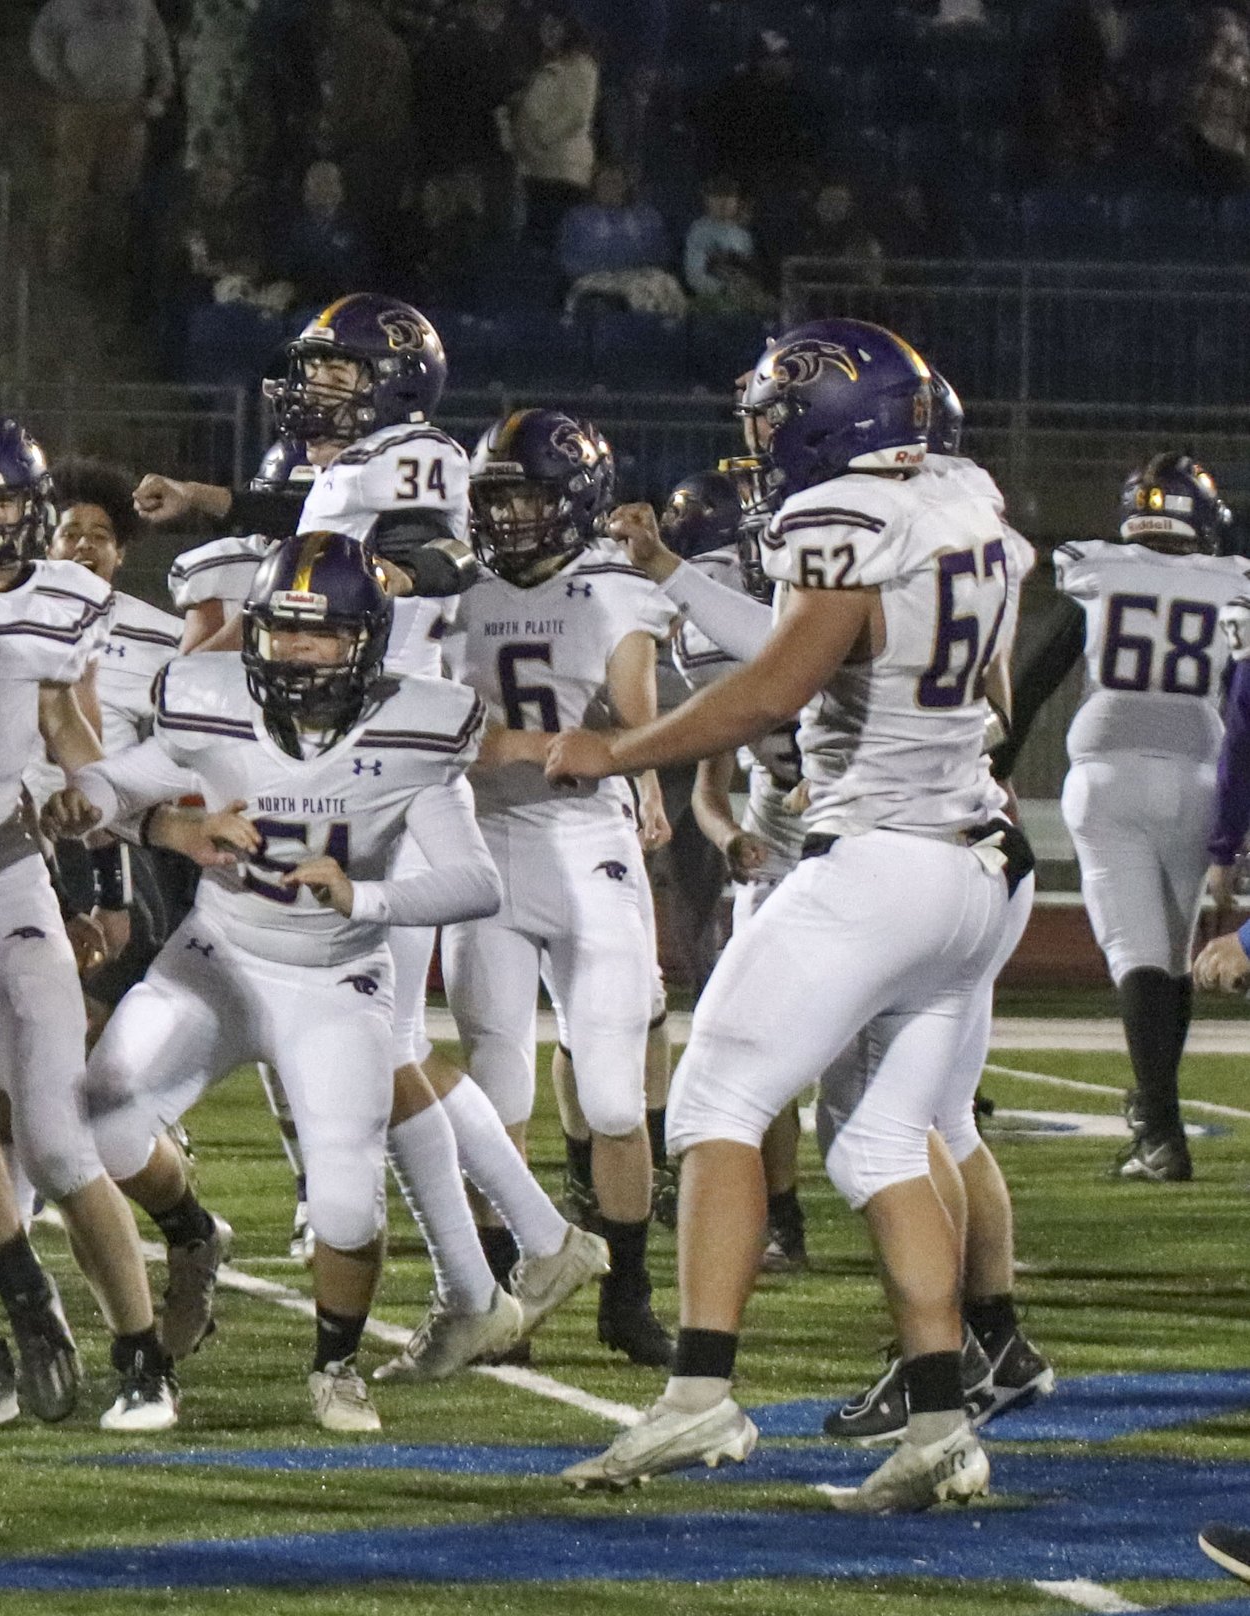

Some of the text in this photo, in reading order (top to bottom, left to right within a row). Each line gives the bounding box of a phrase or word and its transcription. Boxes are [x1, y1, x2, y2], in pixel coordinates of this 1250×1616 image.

[395, 457, 447, 501] 34
[799, 544, 856, 588] 62
[484, 619, 565, 636] NORTH PLATTE
[1100, 592, 1219, 698] 68
[497, 641, 561, 733] 6
[257, 797, 346, 814] NORTH PLATTE
